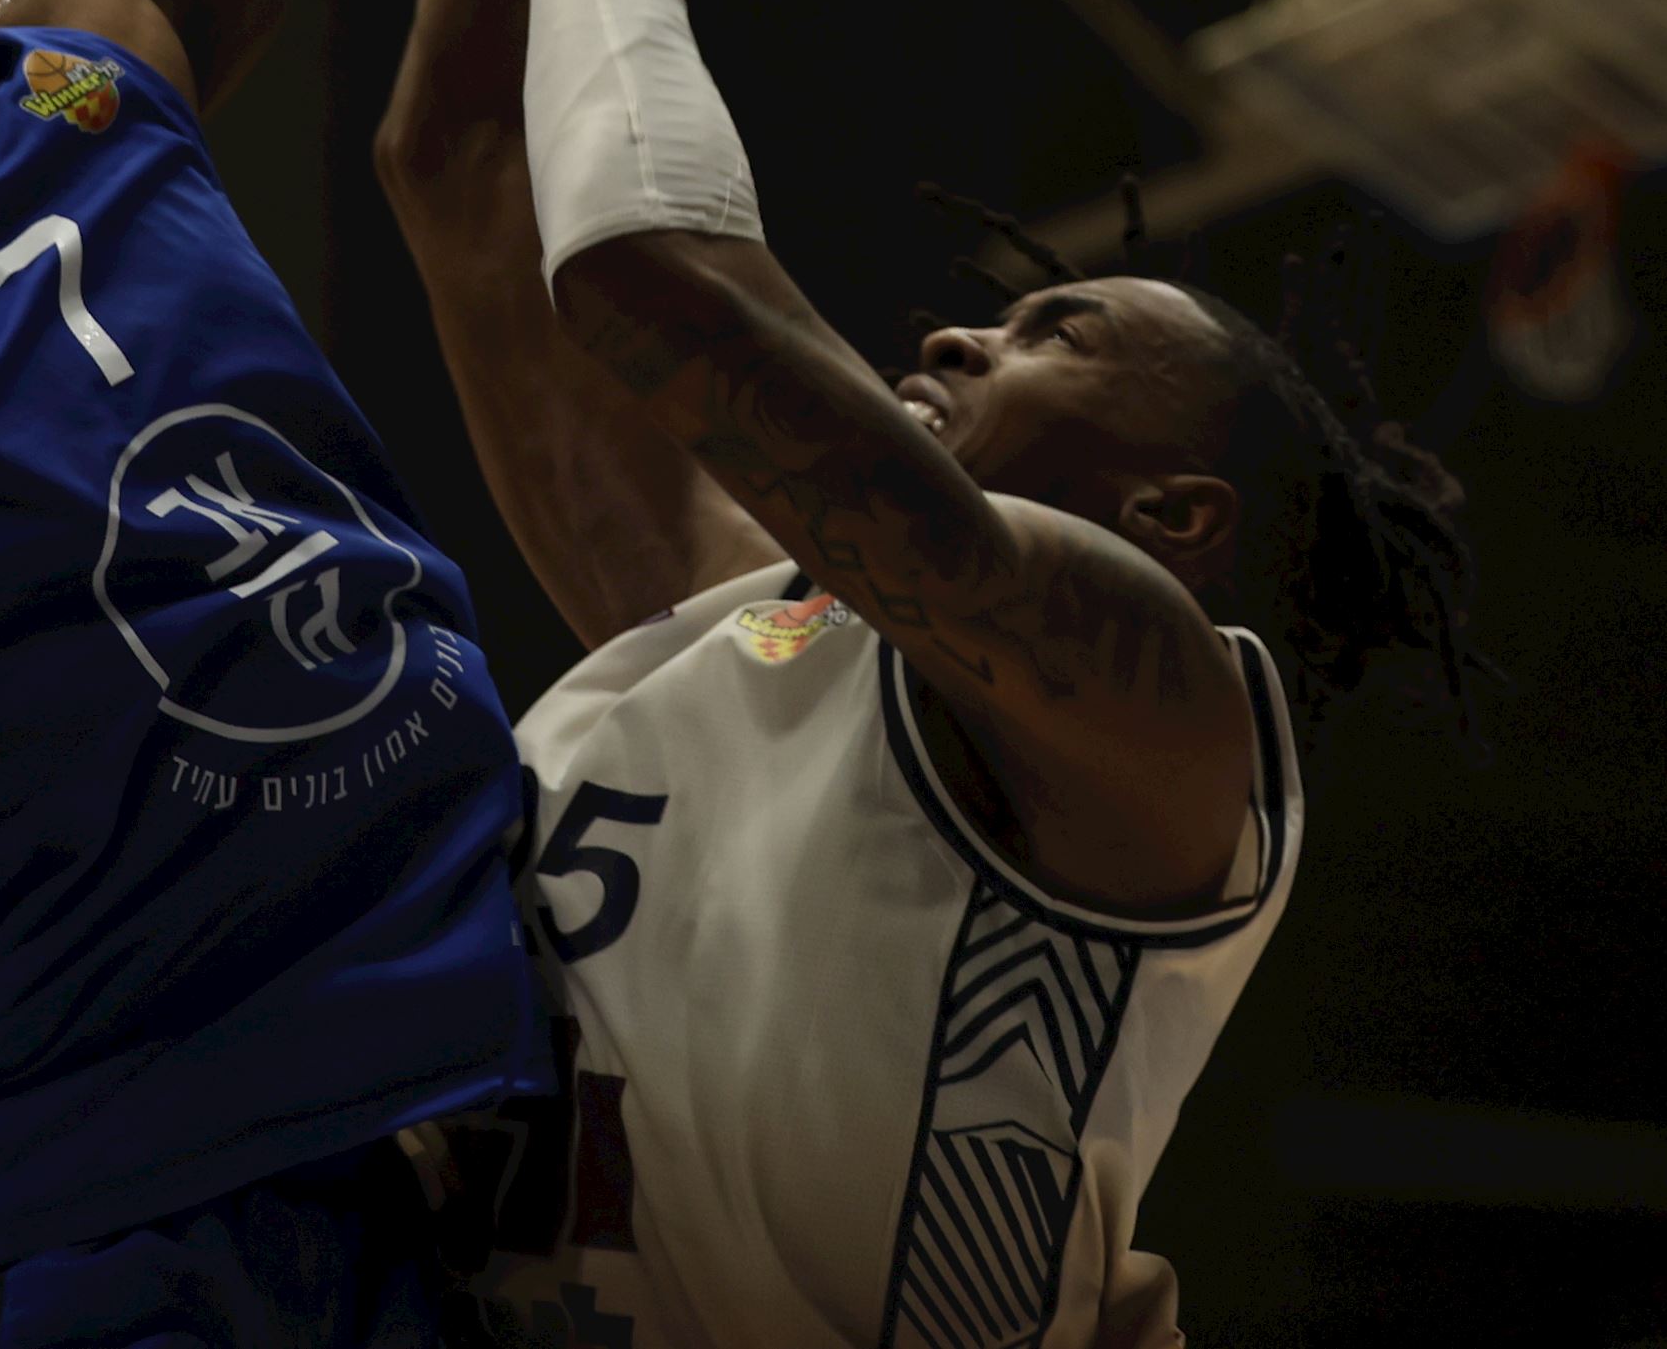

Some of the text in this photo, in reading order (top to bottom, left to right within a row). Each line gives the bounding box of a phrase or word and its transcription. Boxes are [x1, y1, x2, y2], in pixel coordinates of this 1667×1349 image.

[170, 754, 238, 811] עתיד
[261, 765, 350, 813] בונים
[513, 767, 668, 966] 5
